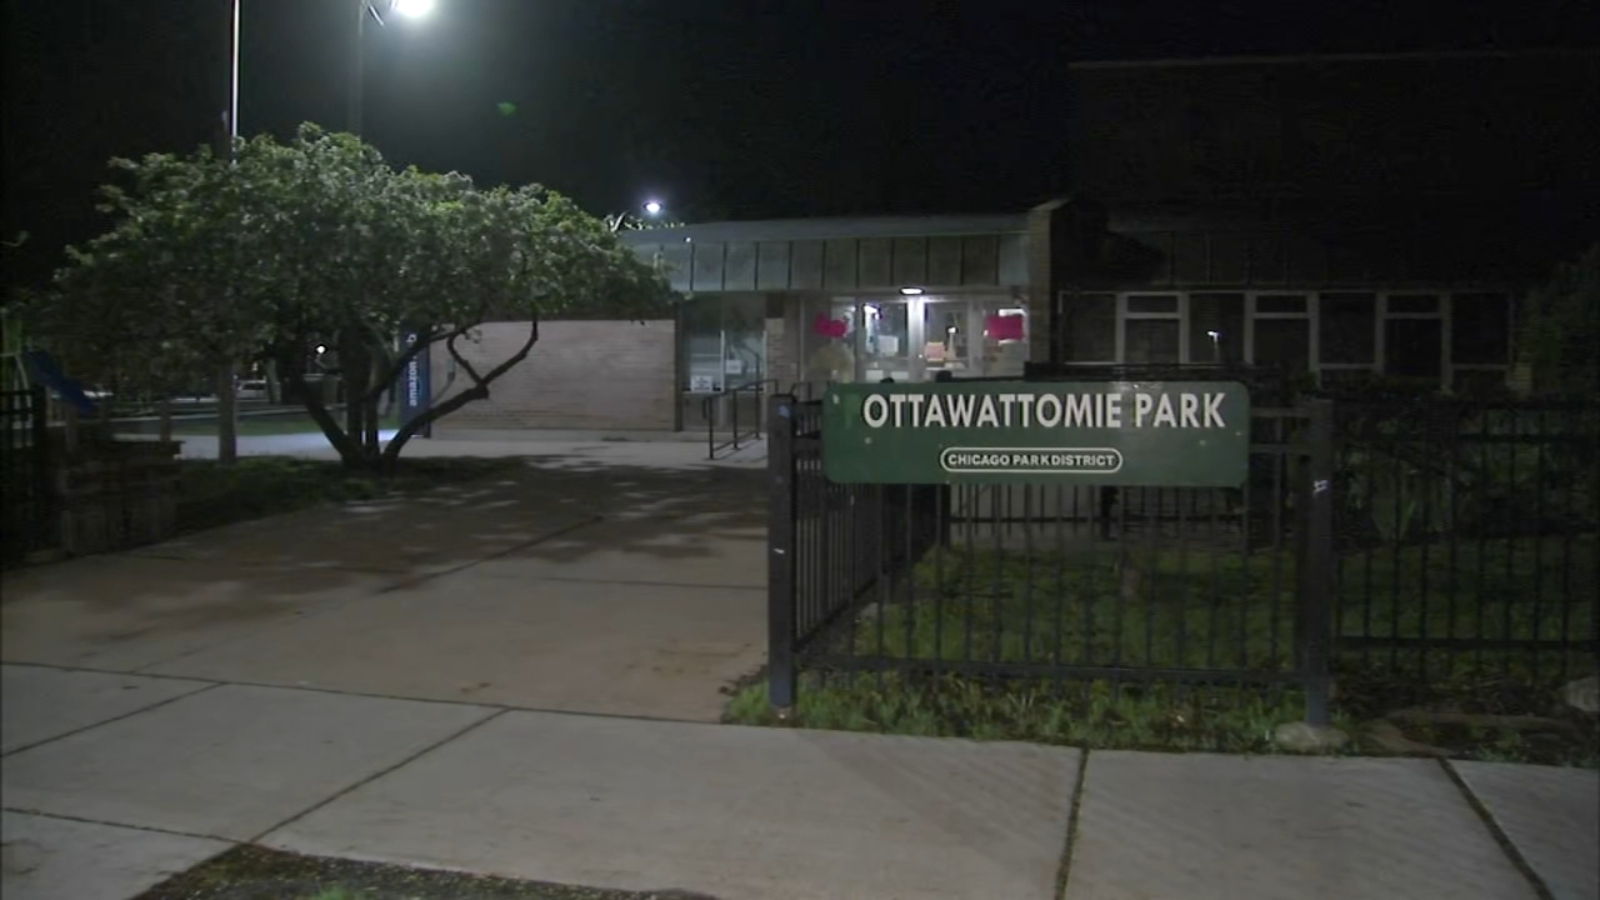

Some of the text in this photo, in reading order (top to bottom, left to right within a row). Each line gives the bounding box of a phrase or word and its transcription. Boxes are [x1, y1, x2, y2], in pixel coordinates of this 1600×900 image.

[863, 393, 1226, 429] OTTAWATTOMIE PARK
[947, 454, 1118, 467] CHICAGO PARK DISTRICT
